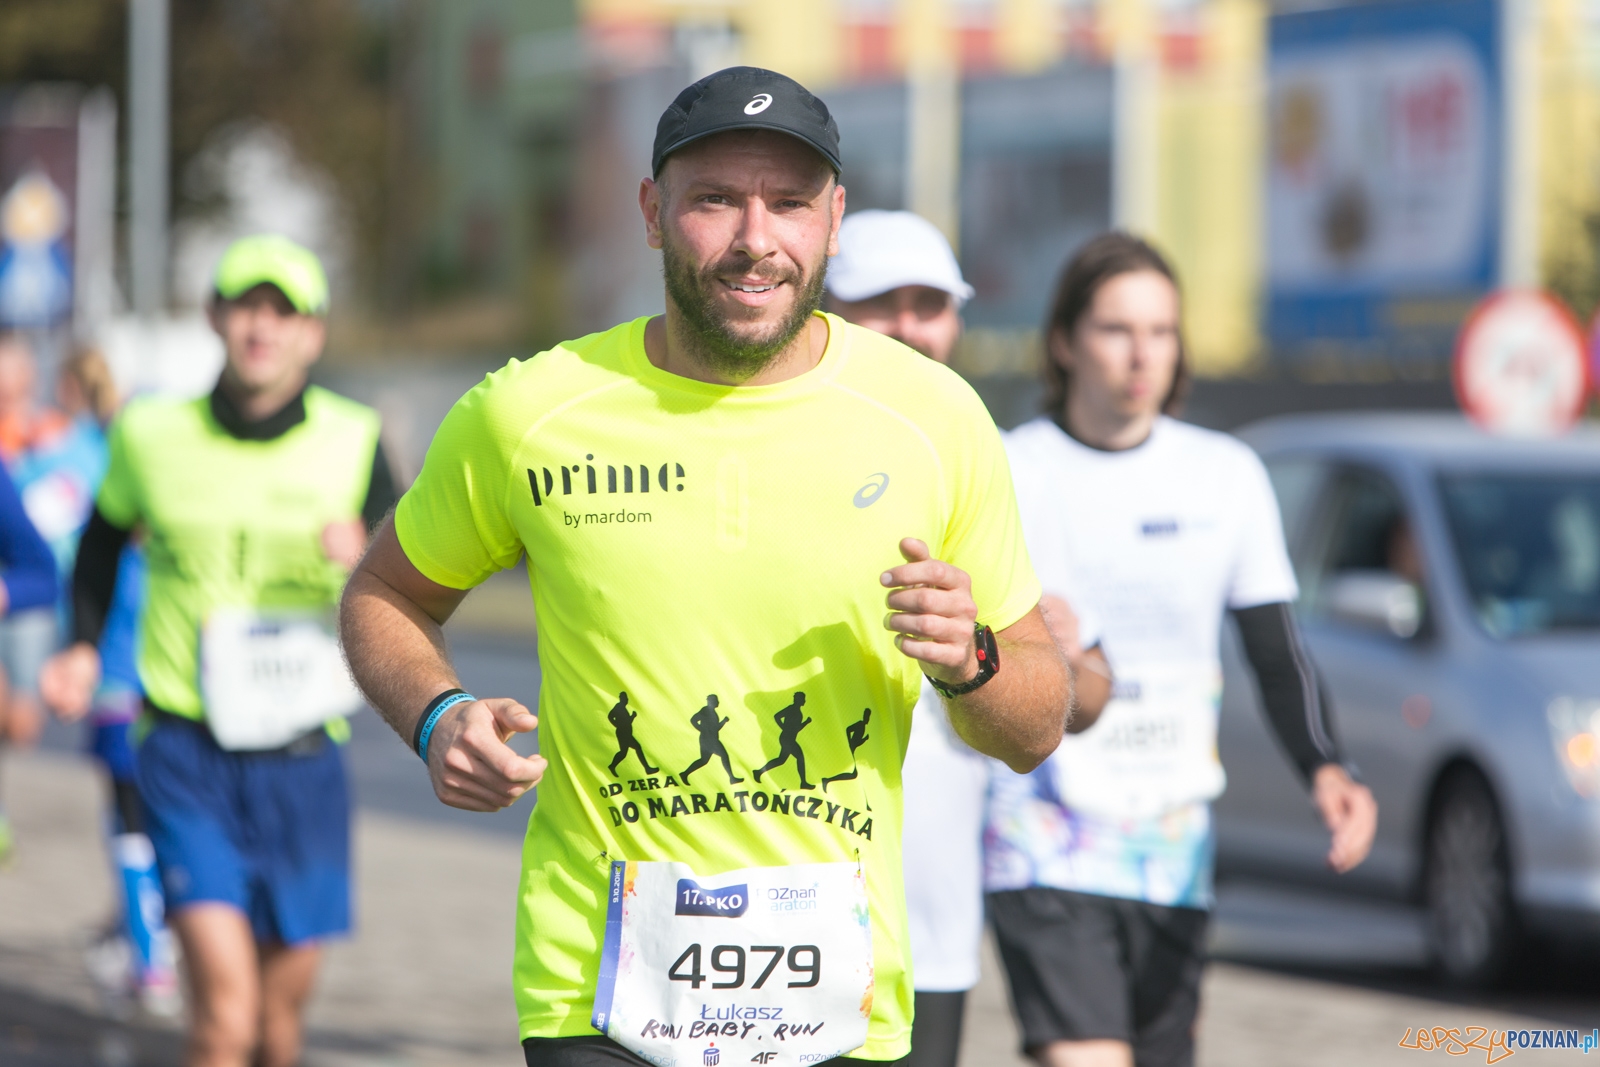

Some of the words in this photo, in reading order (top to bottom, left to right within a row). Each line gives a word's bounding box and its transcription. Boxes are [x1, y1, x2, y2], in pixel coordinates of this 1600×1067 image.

[527, 453, 686, 507] prime
[564, 511, 581, 528] by
[585, 509, 652, 524] mardom
[599, 783, 623, 799] OD
[627, 775, 679, 793] ZERA
[608, 802, 640, 828] DO
[649, 788, 873, 841] MARATOŃCZYKA
[682, 889, 704, 906] 17.
[706, 894, 743, 910] PKO
[756, 887, 817, 901] OZnan
[768, 899, 817, 912] araton
[668, 943, 821, 989] 4979
[700, 1004, 783, 1021] Łukasz
[640, 1019, 683, 1040] RUN
[773, 1021, 825, 1041] RUN
[751, 1052, 778, 1065] 4F
